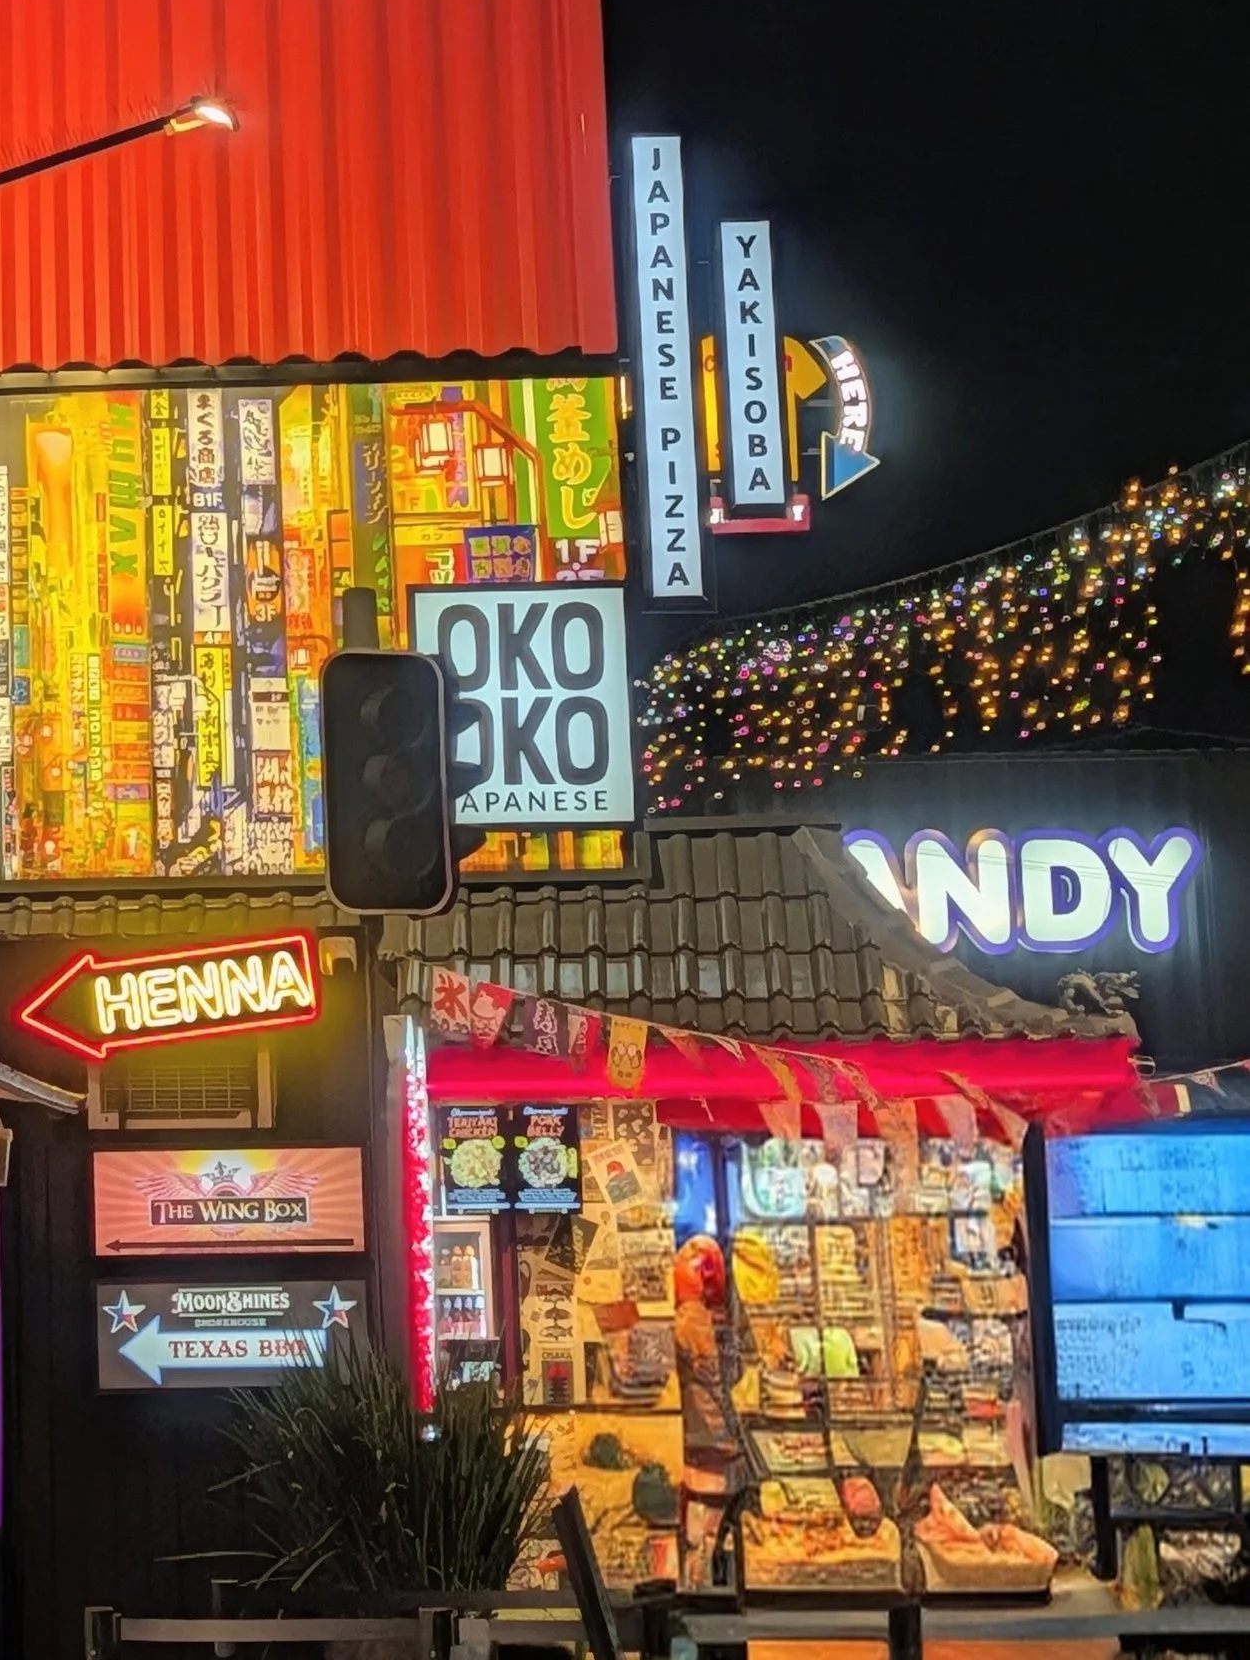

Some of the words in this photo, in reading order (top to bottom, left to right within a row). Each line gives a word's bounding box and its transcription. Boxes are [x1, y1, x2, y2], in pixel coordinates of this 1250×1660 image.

[646, 147, 678, 401] JAPANESE
[734, 234, 772, 492] YAKISOBA
[830, 350, 869, 452] HERE
[193, 491, 223, 507] B1F
[660, 427, 690, 587] PIZZA
[255, 603, 276, 622] 3F
[437, 601, 605, 693] OKO
[94, 951, 312, 1034] HENNA
[434, 973, 468, 1020] 氷
[153, 1201, 195, 1224] THE
[198, 1200, 260, 1222] WING
[264, 1198, 305, 1222] BOX
[168, 1340, 249, 1359] TEXAS
